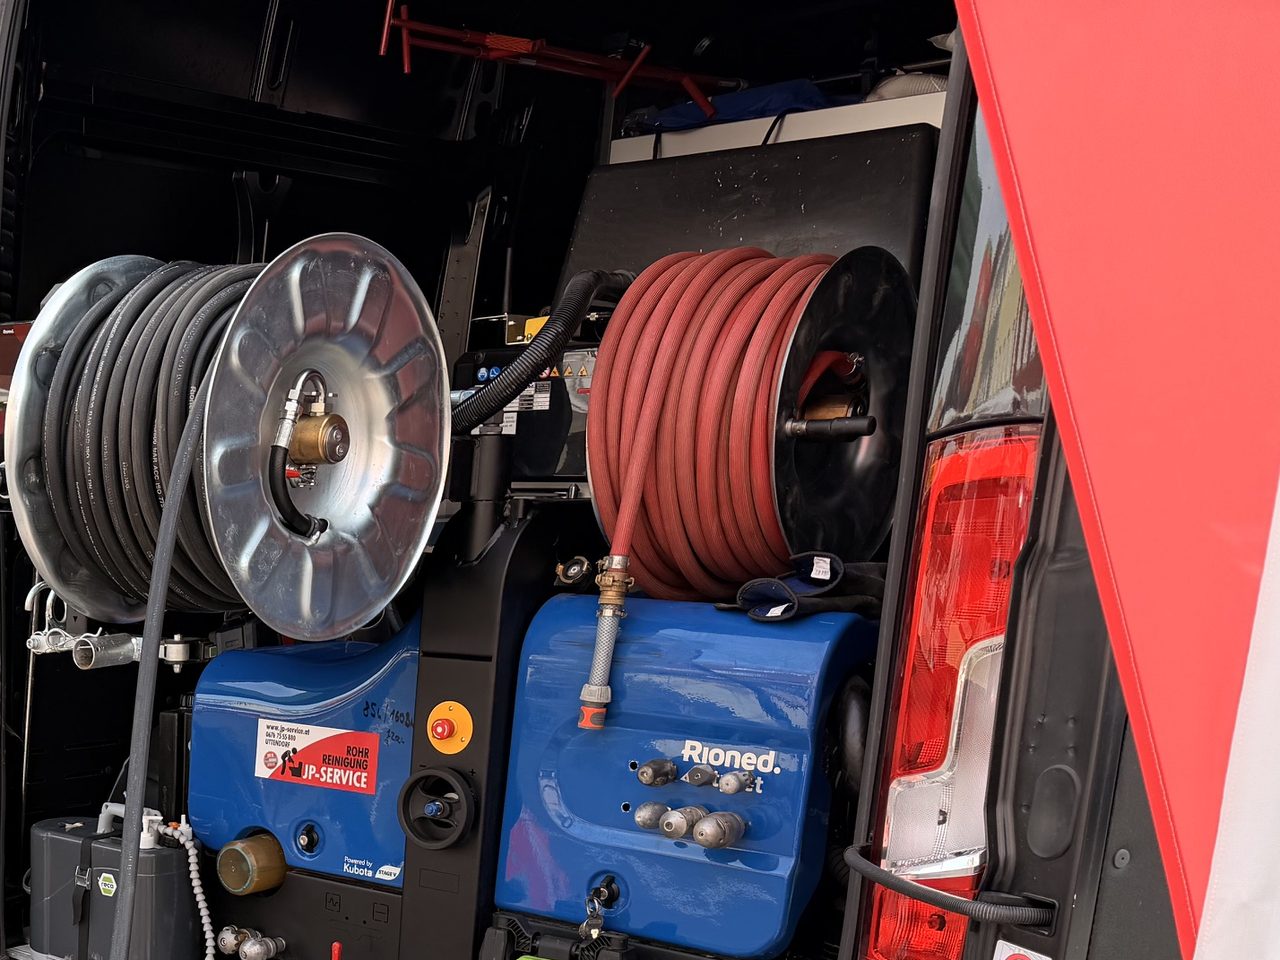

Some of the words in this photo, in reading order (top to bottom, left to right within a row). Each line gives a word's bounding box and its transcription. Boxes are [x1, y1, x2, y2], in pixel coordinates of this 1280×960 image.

[266, 723, 310, 736] www.jp-service.at
[265, 738, 291, 748] UTTENDORF
[346, 745, 369, 759] ROHR
[681, 740, 781, 774] Rioned.
[322, 754, 368, 770] REINIGUNG
[302, 764, 368, 788] JP-SERVICE
[344, 856, 365, 866] Powered
[366, 859, 373, 868] by
[343, 863, 373, 877] Kubota
[379, 869, 393, 877] STAGE
